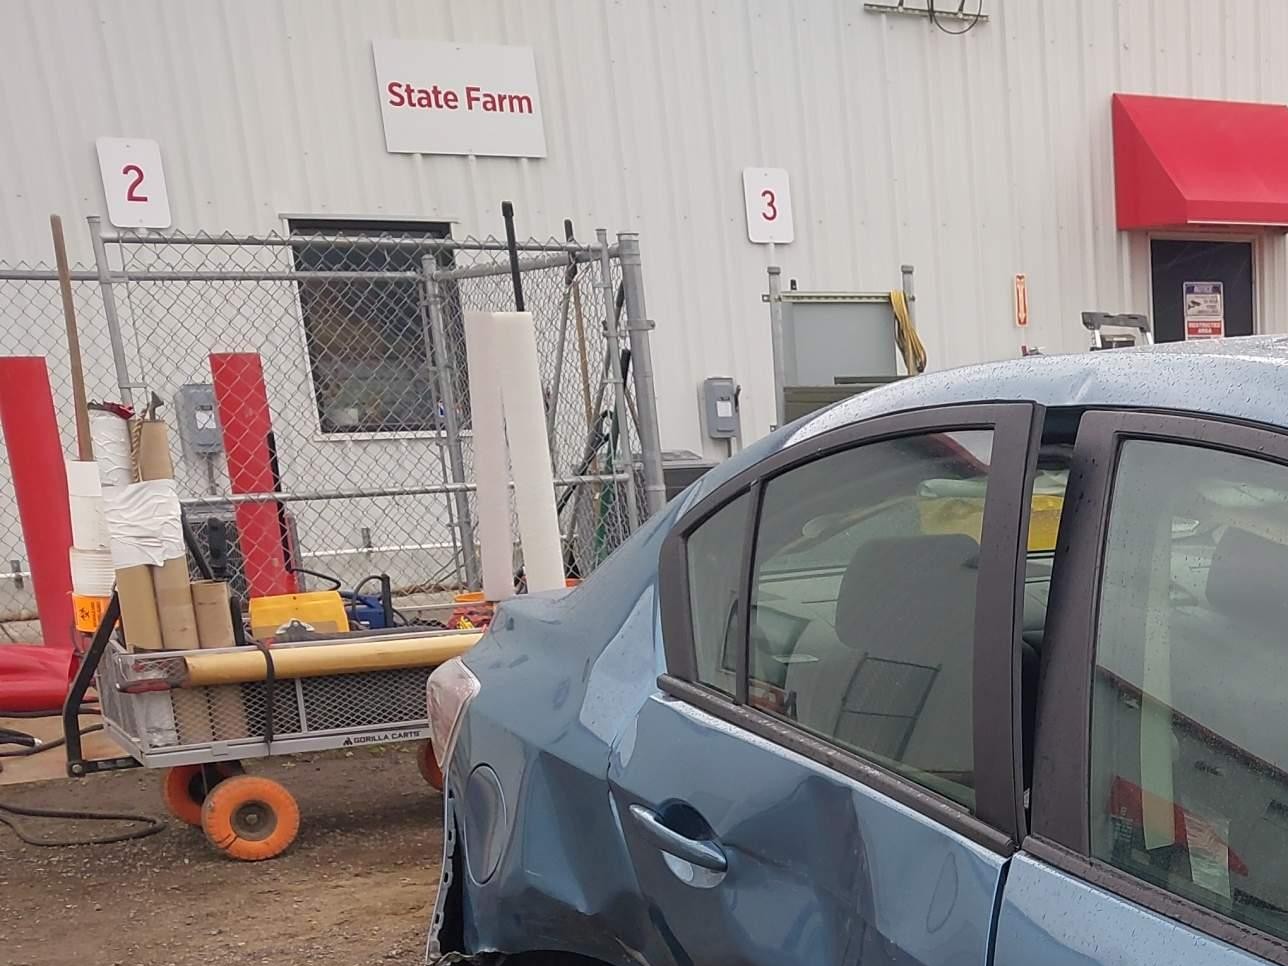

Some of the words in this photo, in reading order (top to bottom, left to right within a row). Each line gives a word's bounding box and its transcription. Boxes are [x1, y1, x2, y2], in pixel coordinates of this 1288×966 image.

[387, 81, 459, 110] State
[465, 86, 533, 114] Farm
[122, 164, 148, 203] 2
[761, 189, 777, 222] 3
[353, 734, 390, 743] GORILLA
[391, 731, 420, 739] CARTS
